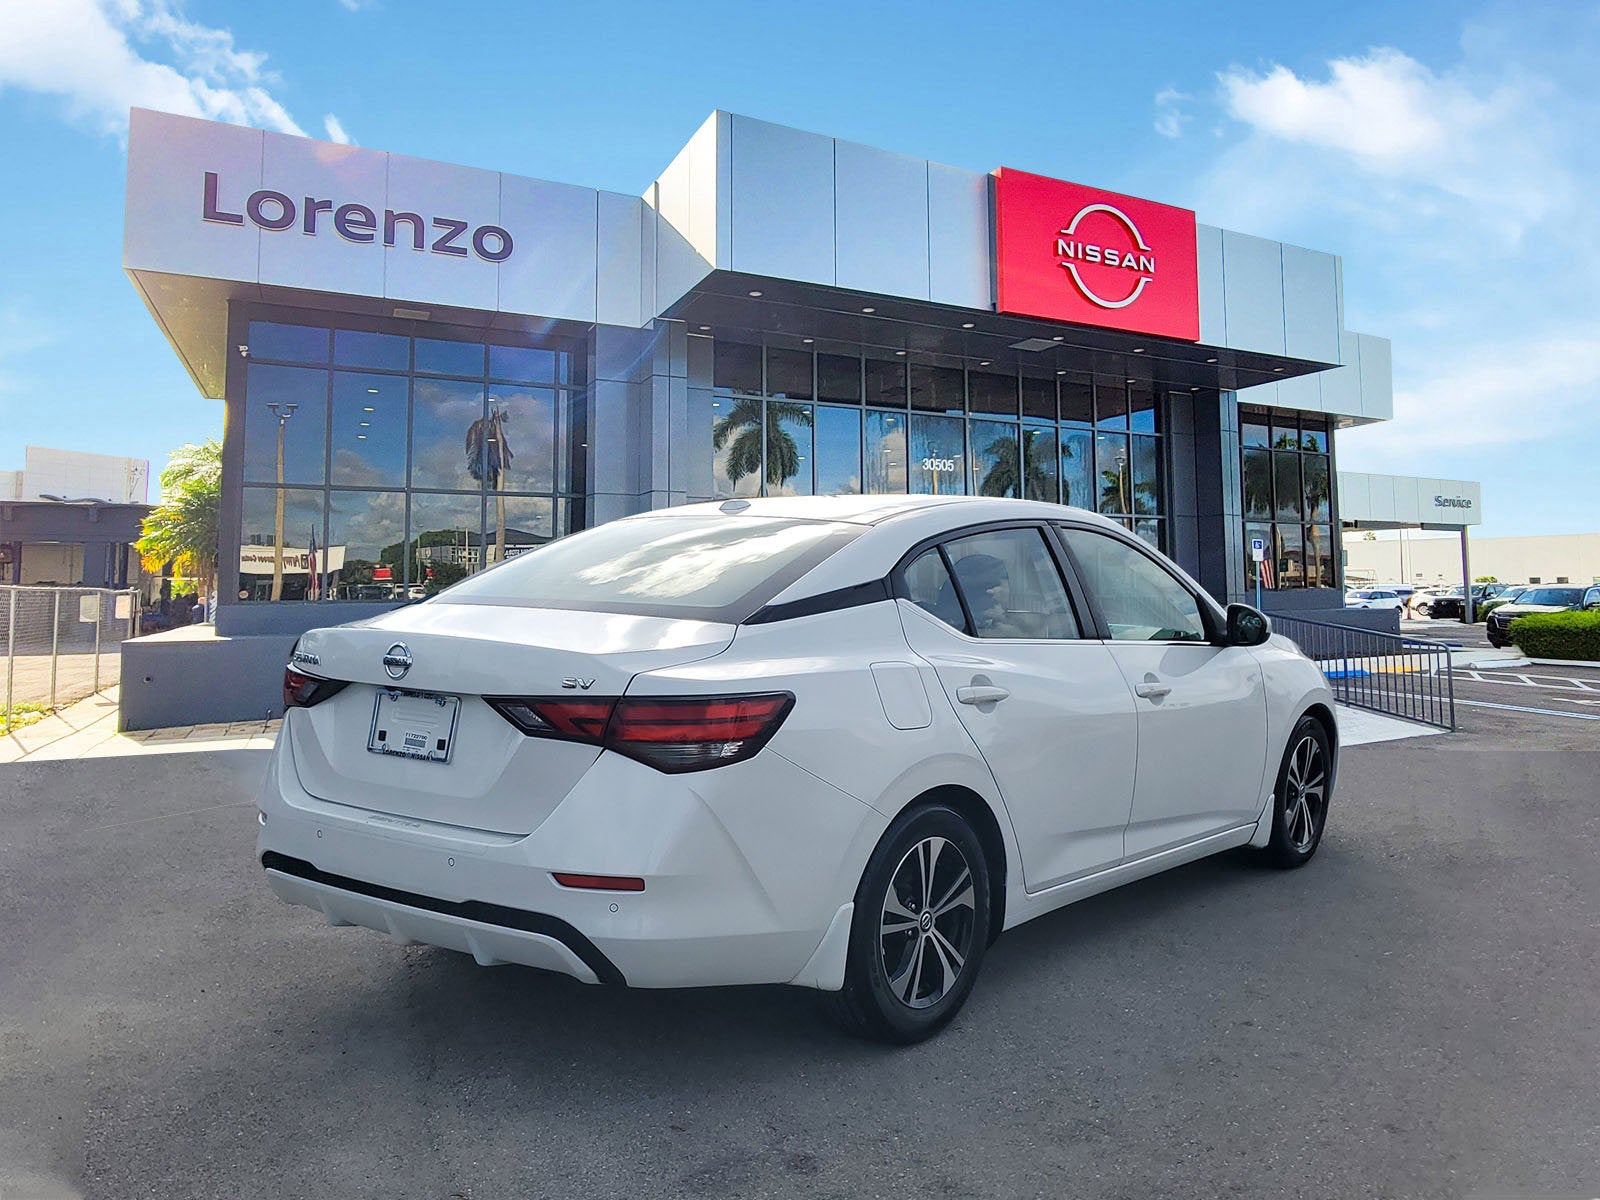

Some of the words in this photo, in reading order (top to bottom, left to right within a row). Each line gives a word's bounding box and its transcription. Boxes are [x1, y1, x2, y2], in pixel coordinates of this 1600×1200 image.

[202, 171, 515, 263] Lorenzo
[1057, 238, 1155, 273] NISSAN
[922, 457, 955, 472] 30505
[1434, 495, 1472, 509] Service
[562, 677, 596, 690] SV
